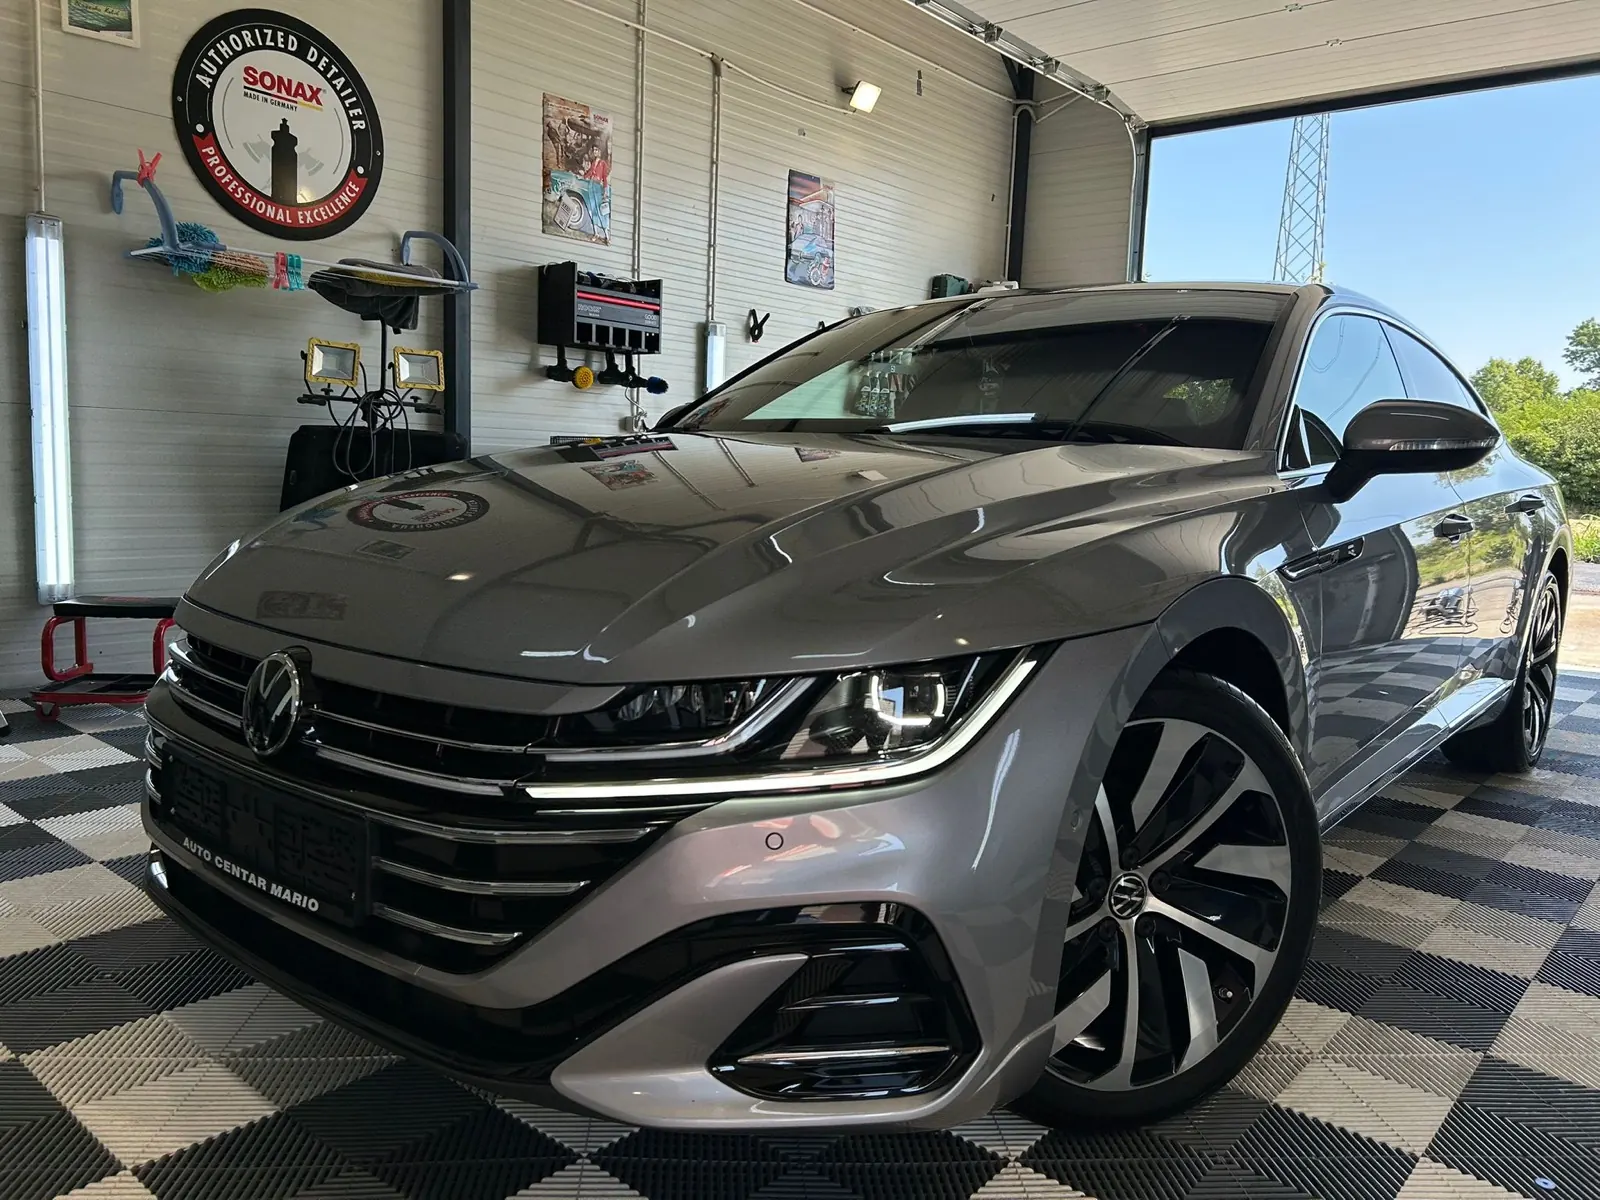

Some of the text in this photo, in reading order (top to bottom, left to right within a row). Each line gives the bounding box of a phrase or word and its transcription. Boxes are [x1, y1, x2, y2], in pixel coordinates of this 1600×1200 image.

[196, 29, 366, 131] AUTHORIZED DETAILER
[243, 66, 323, 106] SONAX
[243, 91, 298, 112] MADE IN GERMANY
[202, 146, 360, 225] PROFESSIONAL EXCELLENCE
[183, 837, 320, 912] AUTO CENTAR MARIO
